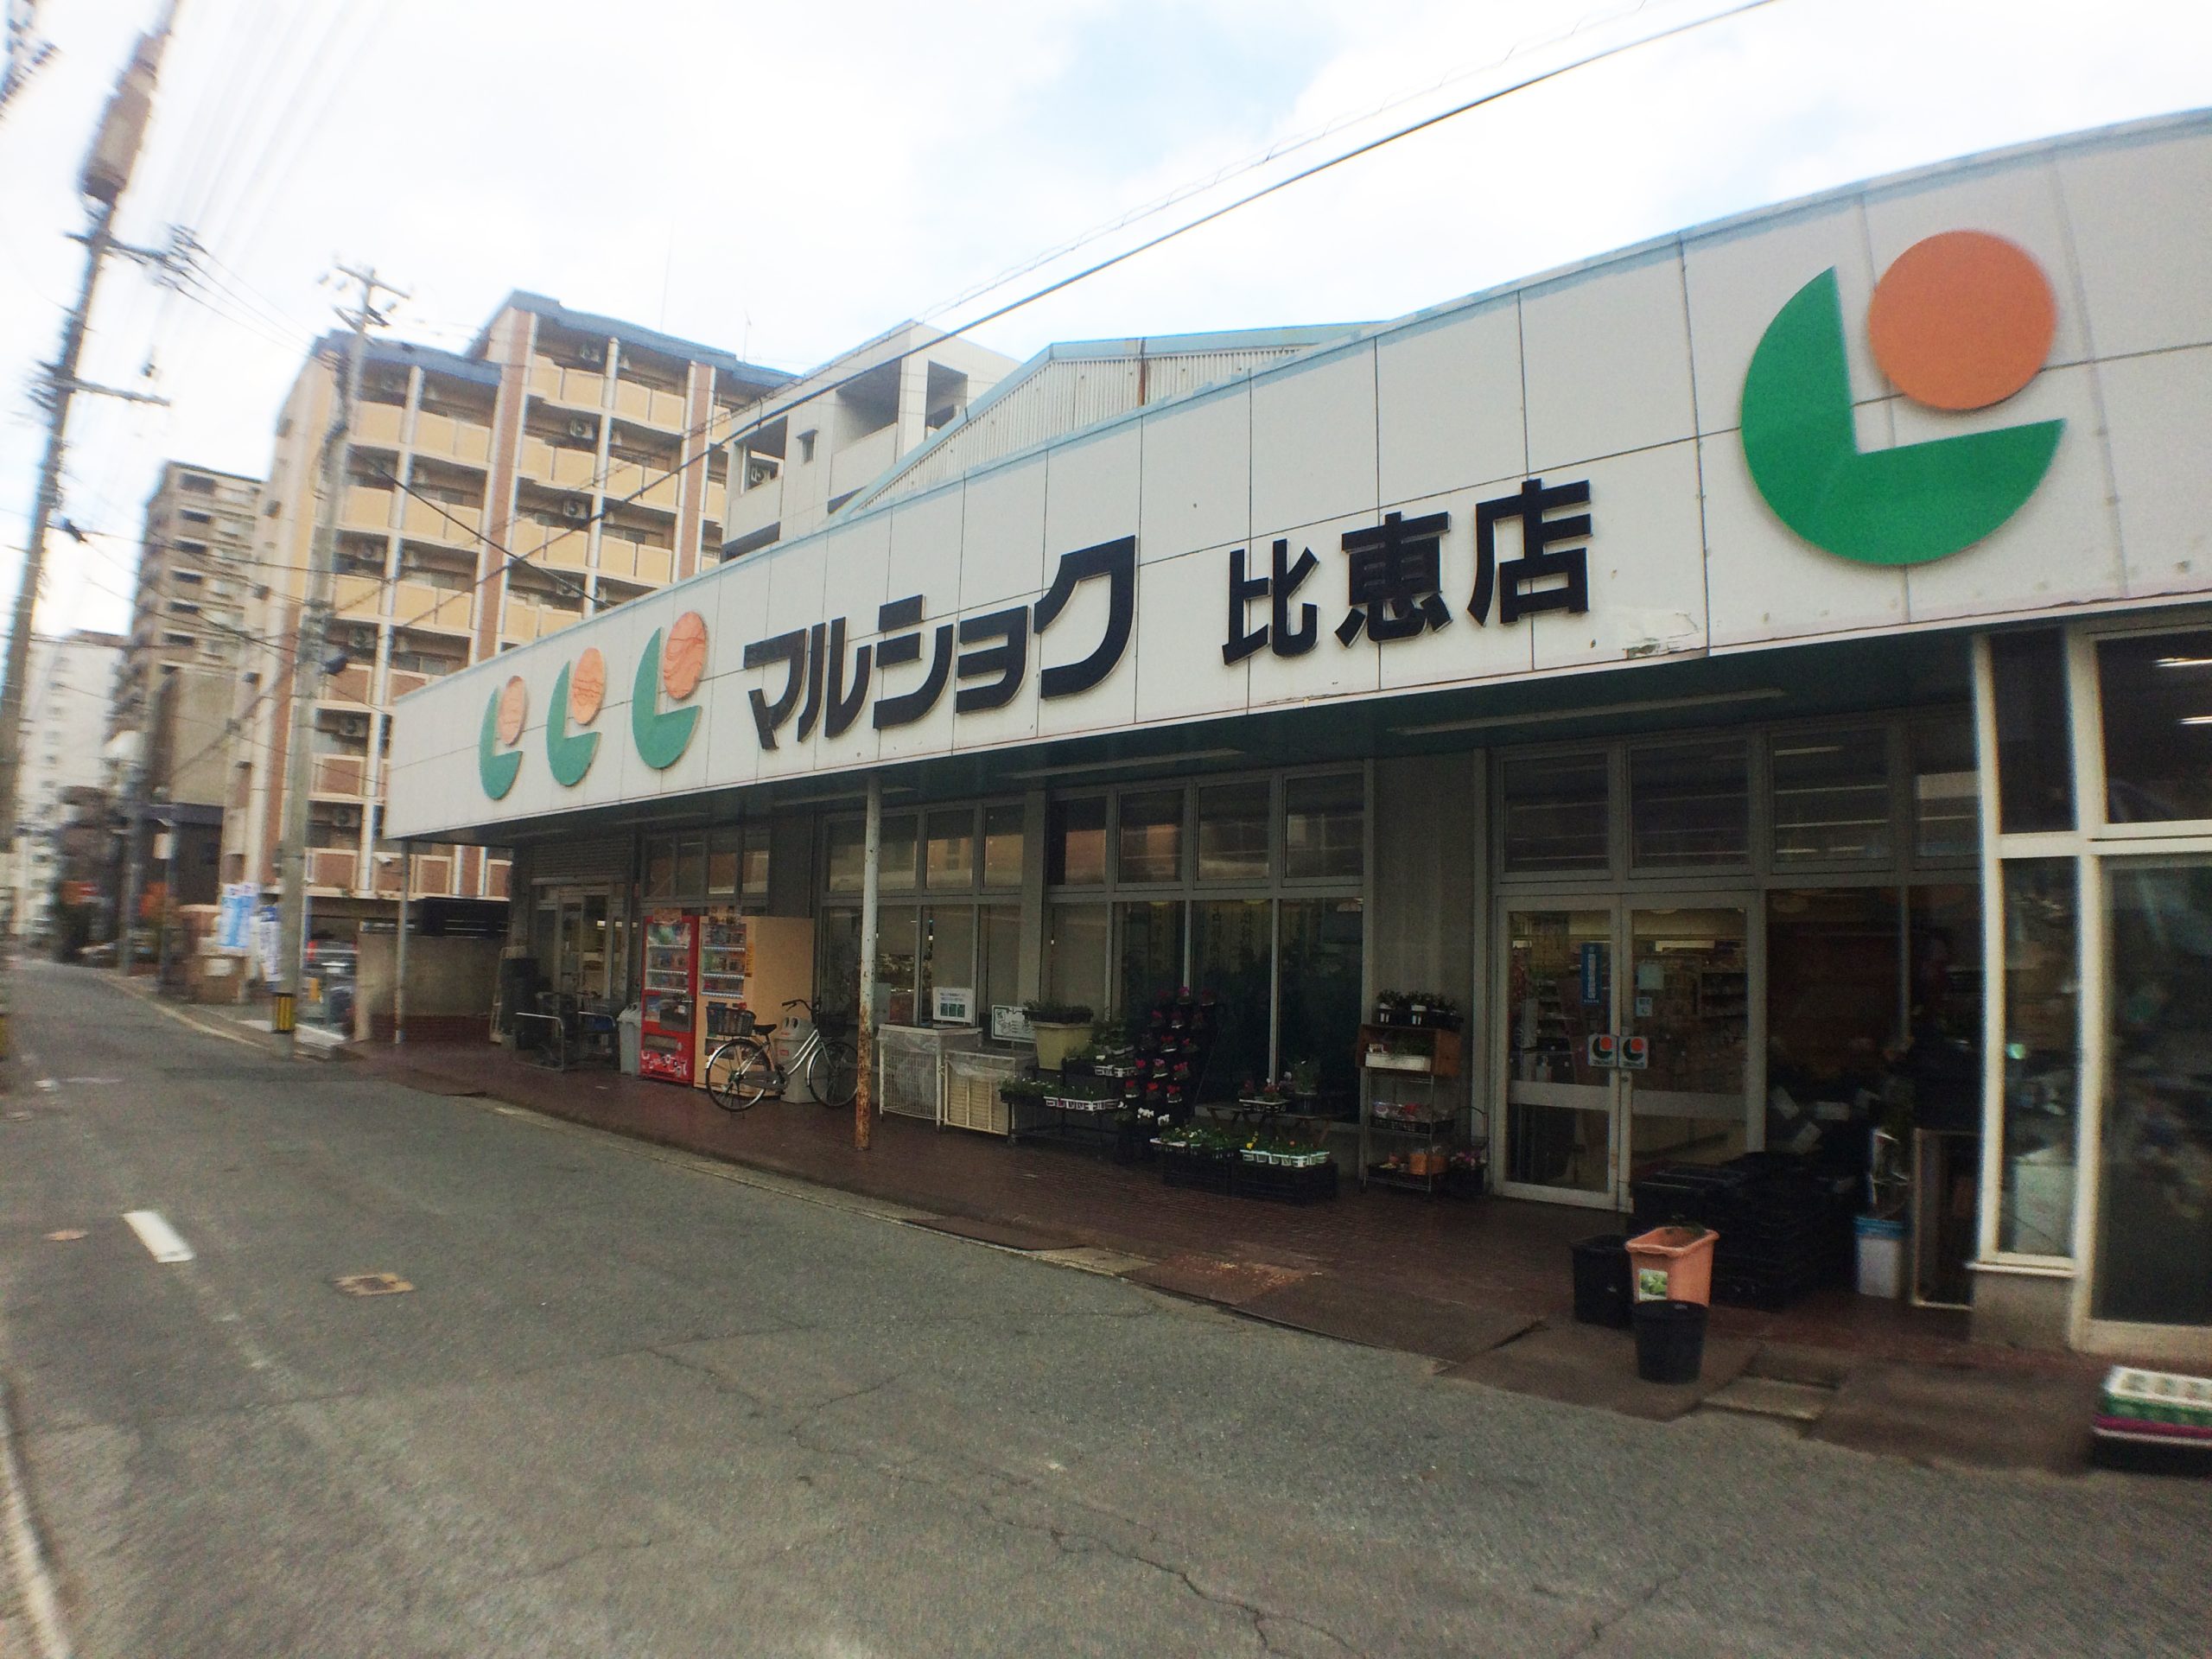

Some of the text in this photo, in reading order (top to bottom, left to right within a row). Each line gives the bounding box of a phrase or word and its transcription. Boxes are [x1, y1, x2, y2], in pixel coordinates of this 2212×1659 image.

[744, 478, 1592, 750] マルショク 比恵店
